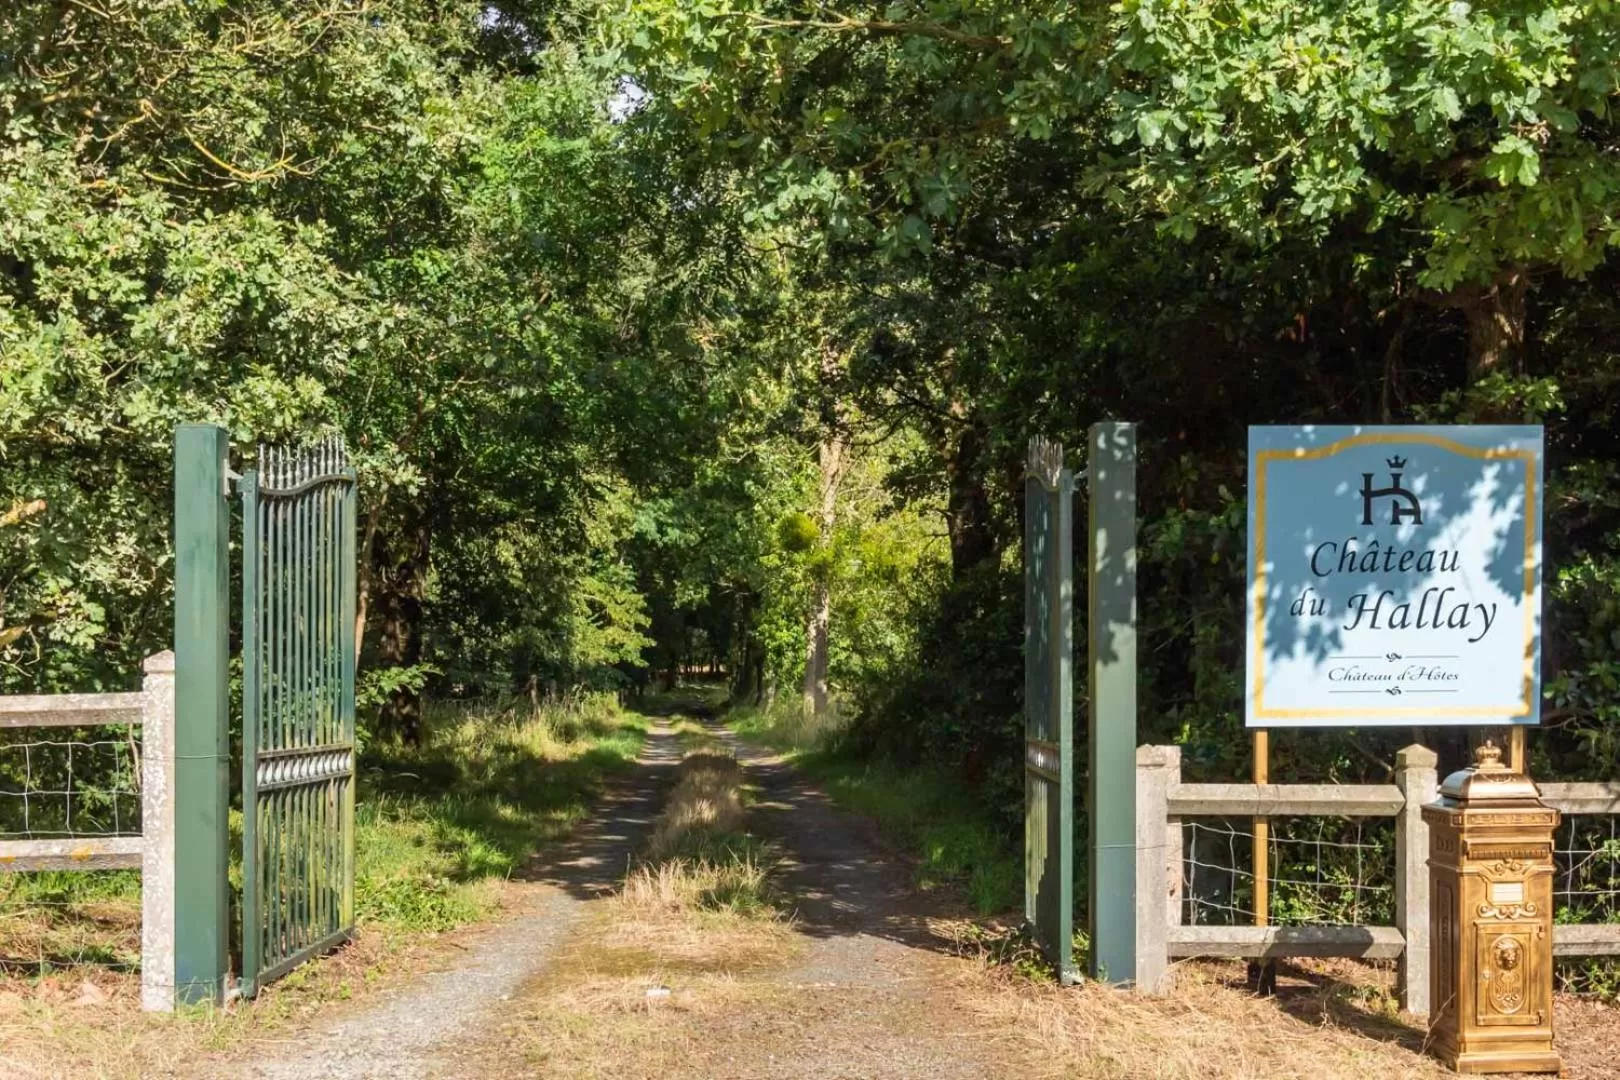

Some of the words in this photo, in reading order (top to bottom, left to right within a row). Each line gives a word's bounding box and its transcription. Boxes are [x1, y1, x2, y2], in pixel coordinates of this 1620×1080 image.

[1310, 536, 1460, 577] Château
[1290, 587, 1326, 616] du
[1343, 587, 1497, 643] Hallay
[1328, 665, 1391, 681] Château
[1397, 665, 1459, 681] d'Hôtes
